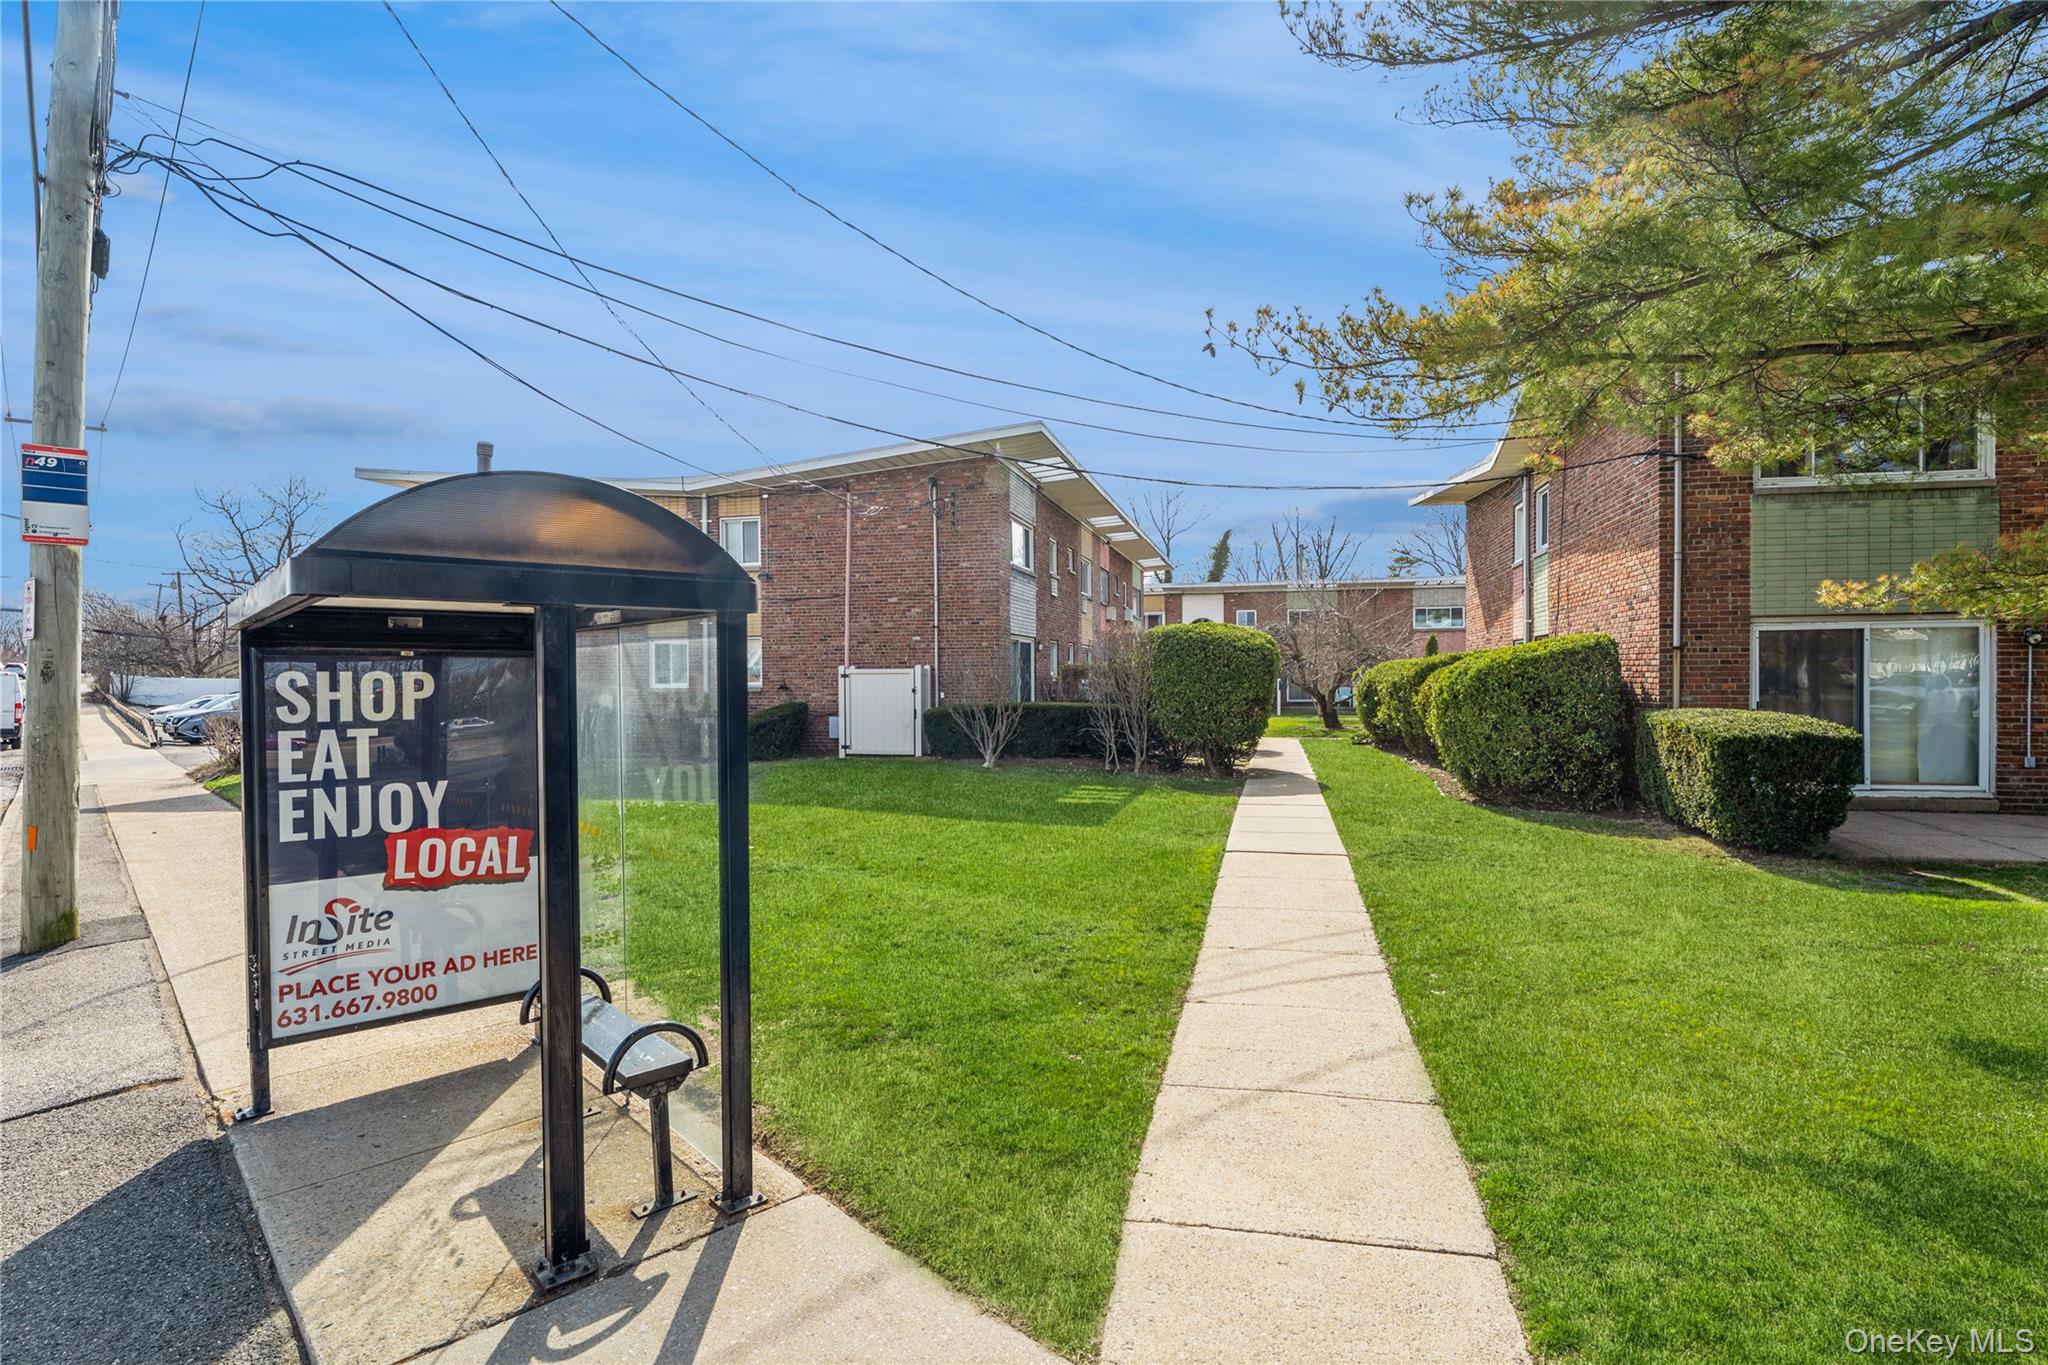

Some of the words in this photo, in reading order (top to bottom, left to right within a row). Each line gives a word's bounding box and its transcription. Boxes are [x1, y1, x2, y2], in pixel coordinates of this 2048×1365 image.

[24, 456, 58, 468] n49
[275, 670, 435, 723] SHOP
[277, 727, 379, 784] EAT
[279, 780, 448, 843] ENJOY
[394, 835, 526, 880] LOCAL
[285, 897, 394, 946] InSite
[278, 971, 361, 1004] PLACE
[368, 959, 436, 989] YOUR
[442, 954, 477, 976] AD
[483, 943, 538, 972] HERE
[282, 942, 338, 961] STREET
[345, 937, 392, 953] MEDIA
[276, 983, 438, 1029] 631.667.9800
